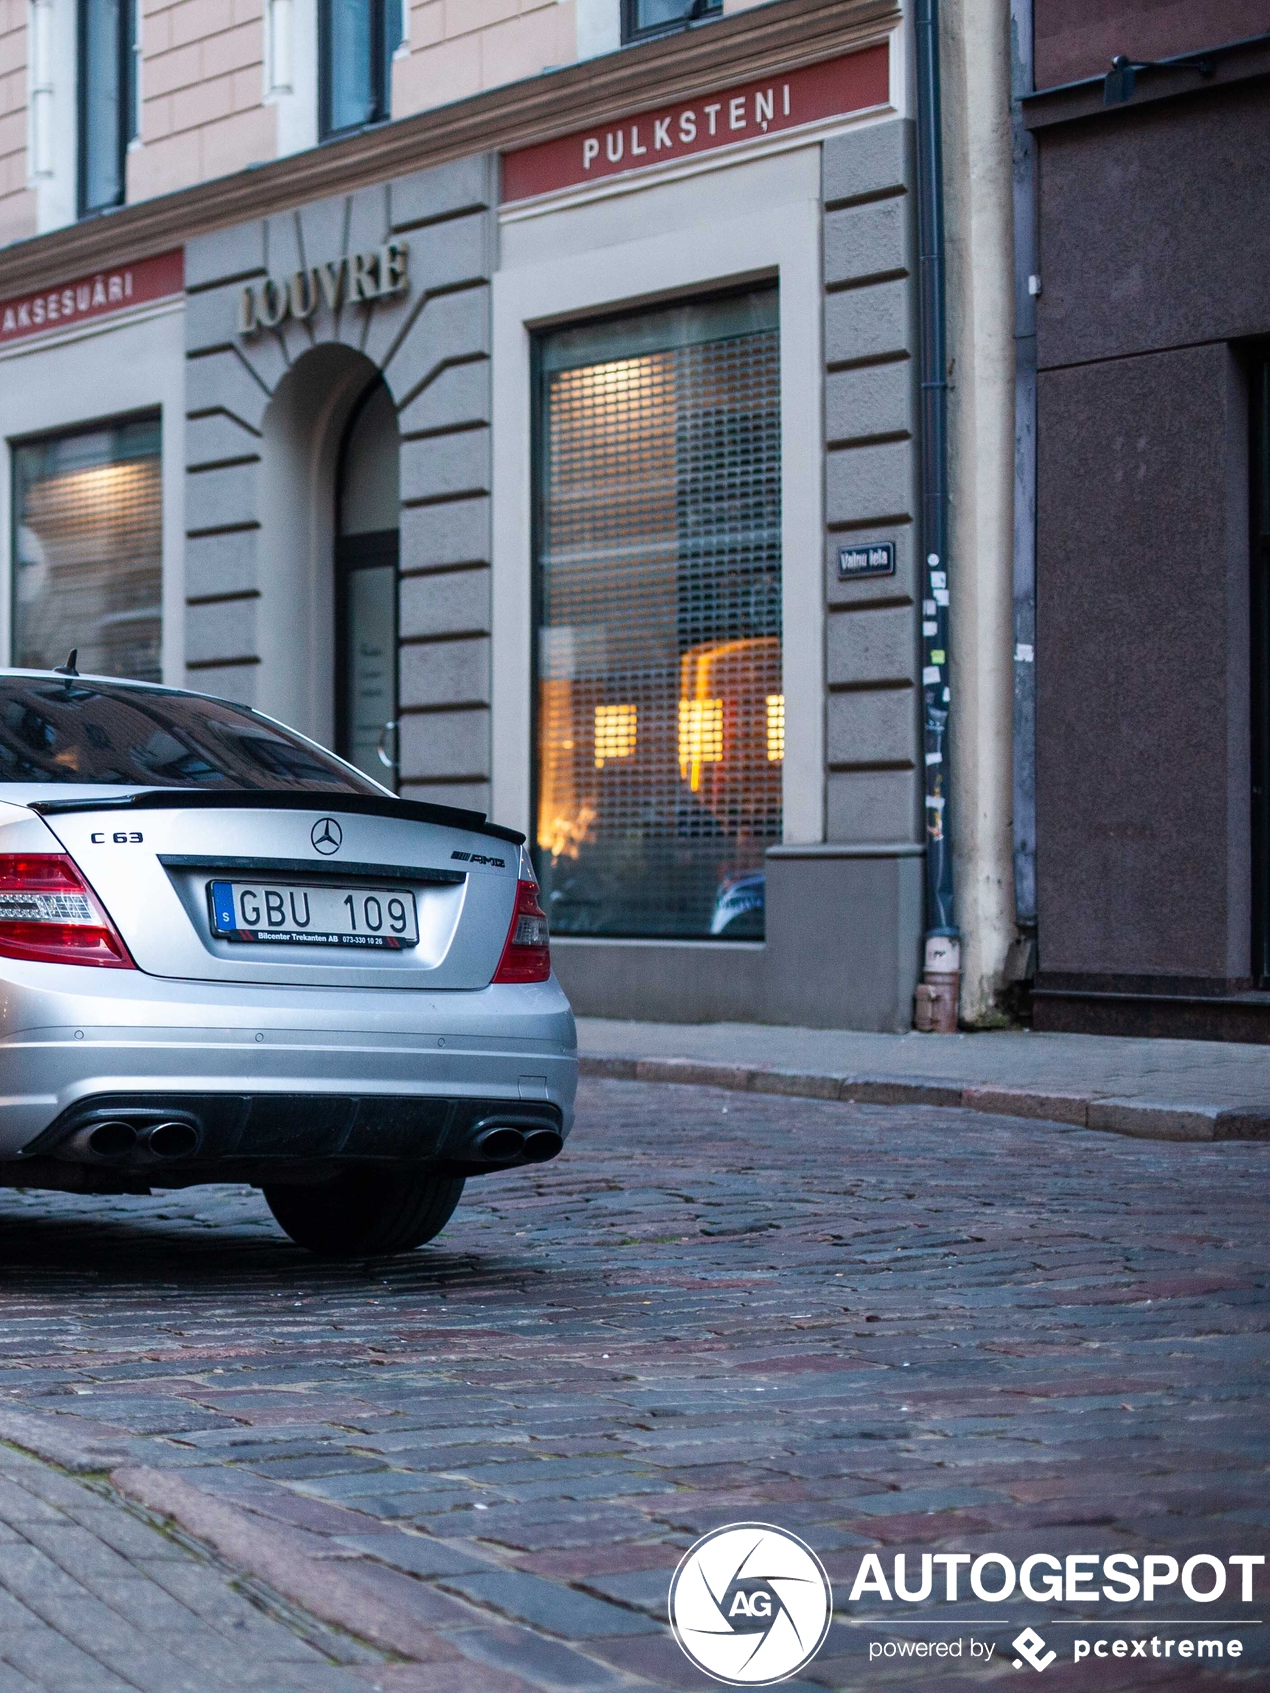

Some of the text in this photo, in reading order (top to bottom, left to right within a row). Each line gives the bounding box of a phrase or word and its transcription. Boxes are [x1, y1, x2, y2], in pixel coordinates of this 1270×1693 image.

[582, 84, 790, 170] PULKSTEŅI
[237, 241, 411, 334] LOUVRE
[90, 831, 144, 844] C 63
[222, 911, 230, 923] S
[239, 889, 407, 934] GBU 109
[257, 931, 290, 941] Bilcenter
[291, 933, 327, 942] Trekanten
[328, 935, 339, 943] AB
[342, 935, 366, 944] 073-330
